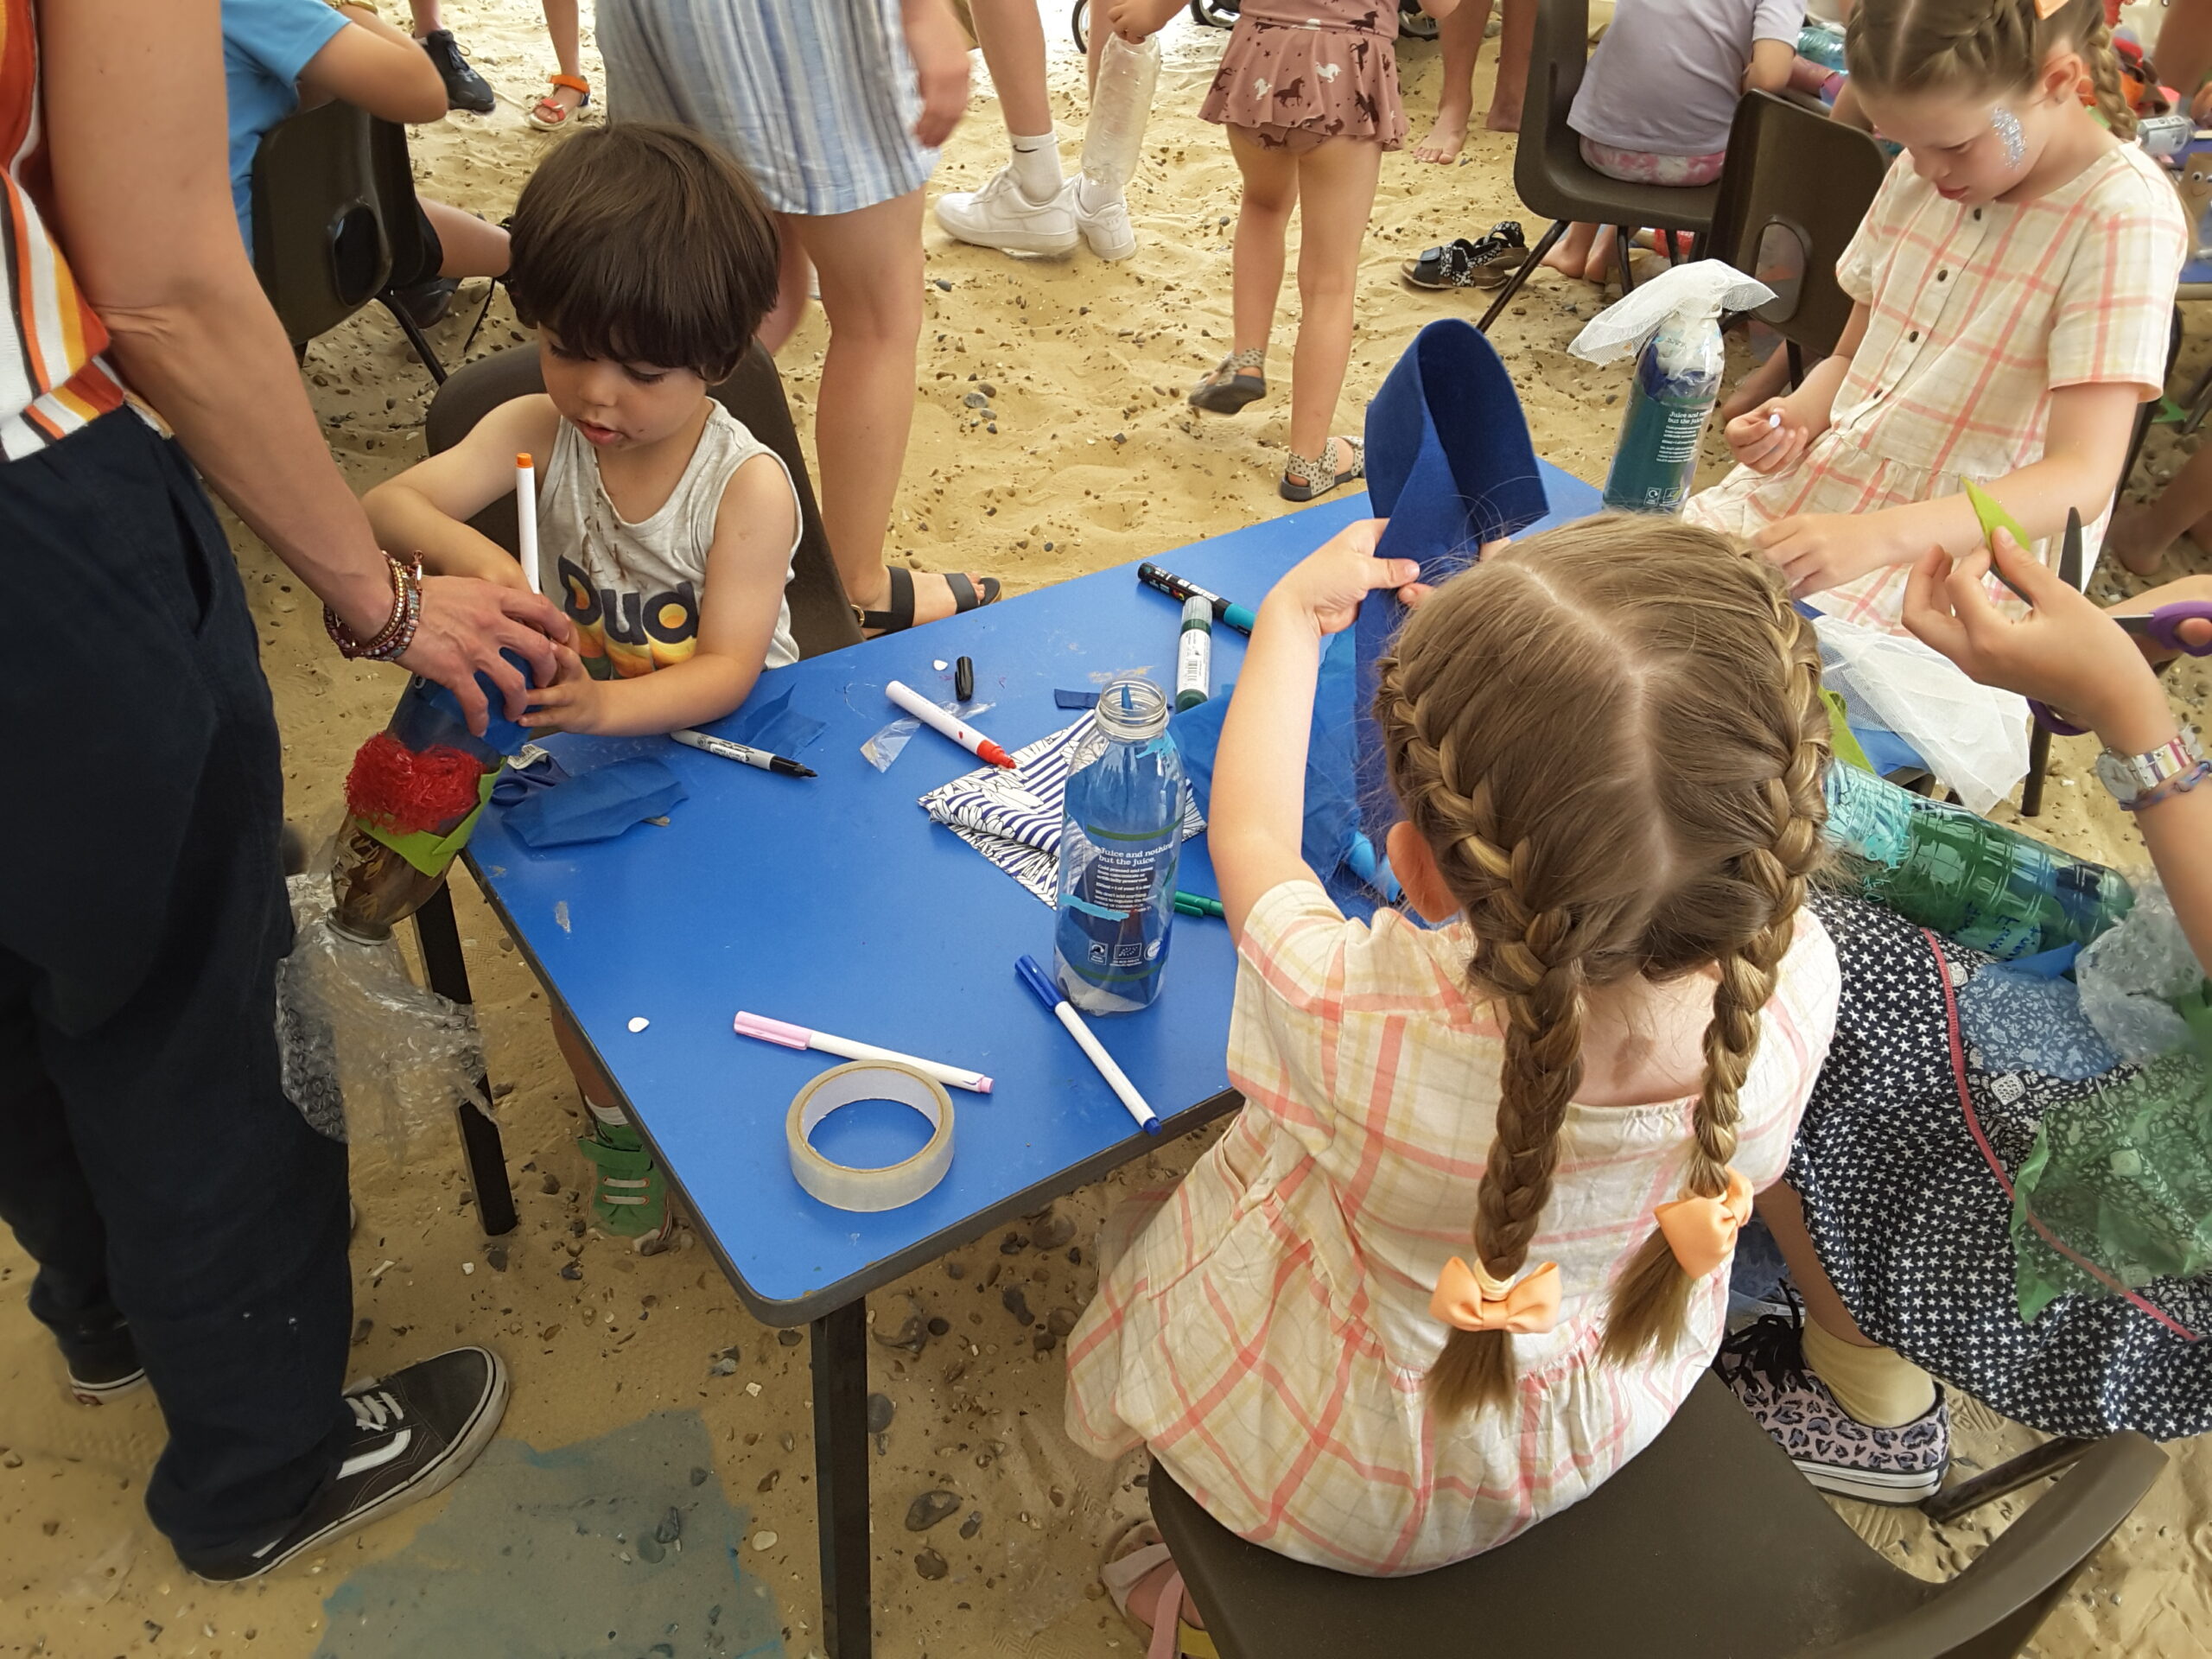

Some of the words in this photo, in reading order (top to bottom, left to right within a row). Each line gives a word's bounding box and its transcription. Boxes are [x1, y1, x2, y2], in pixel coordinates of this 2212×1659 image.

[1100, 847, 1124, 857] Juice
[1145, 841, 1173, 856] nothing
[1098, 855, 1115, 863] but
[1132, 857, 1155, 867] juice.
